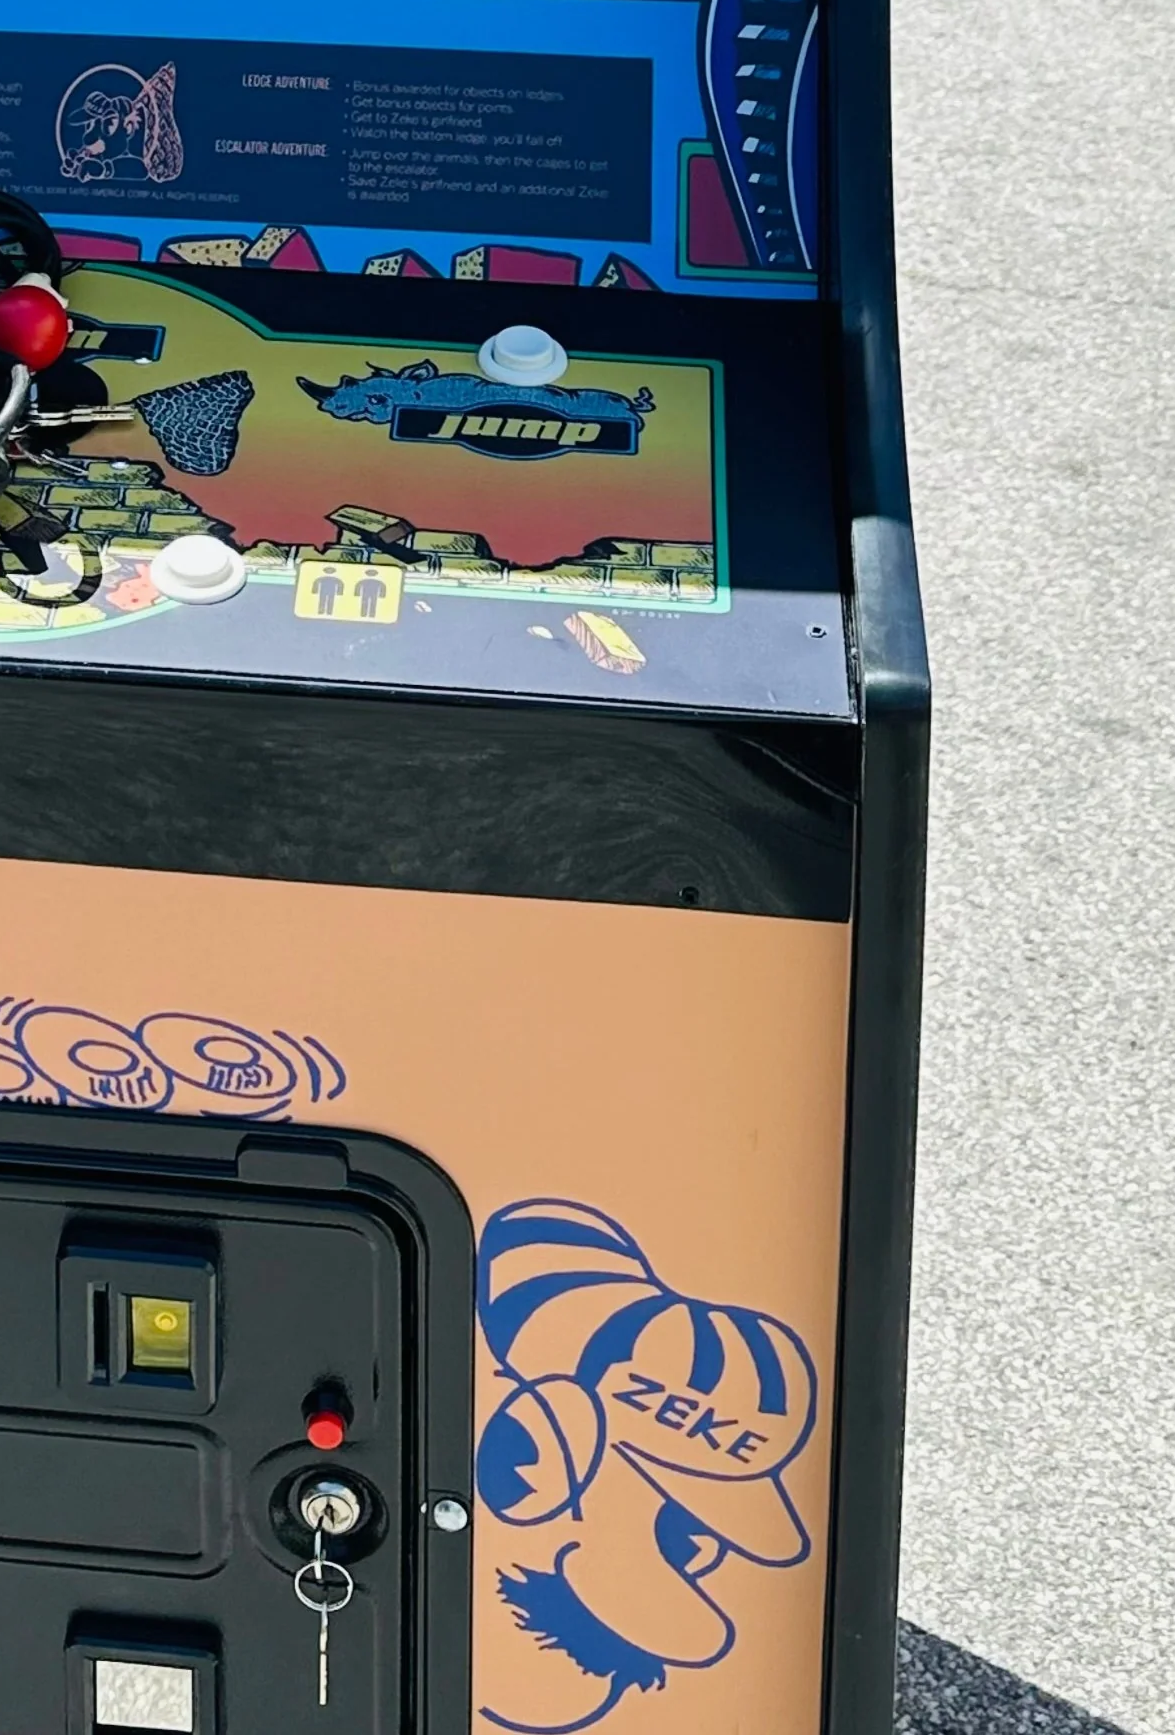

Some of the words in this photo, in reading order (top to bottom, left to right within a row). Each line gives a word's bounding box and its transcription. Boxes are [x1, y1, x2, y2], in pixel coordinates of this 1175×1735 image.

[242, 74, 272, 88] LEDGE
[351, 95, 373, 107] Get
[350, 111, 372, 123] Get
[376, 113, 388, 124] to
[351, 127, 387, 138] Watch
[215, 139, 269, 154] ESCALATOR
[348, 174, 376, 187] Save
[427, 413, 602, 446] jump
[612, 1372, 769, 1463] ZEKE
